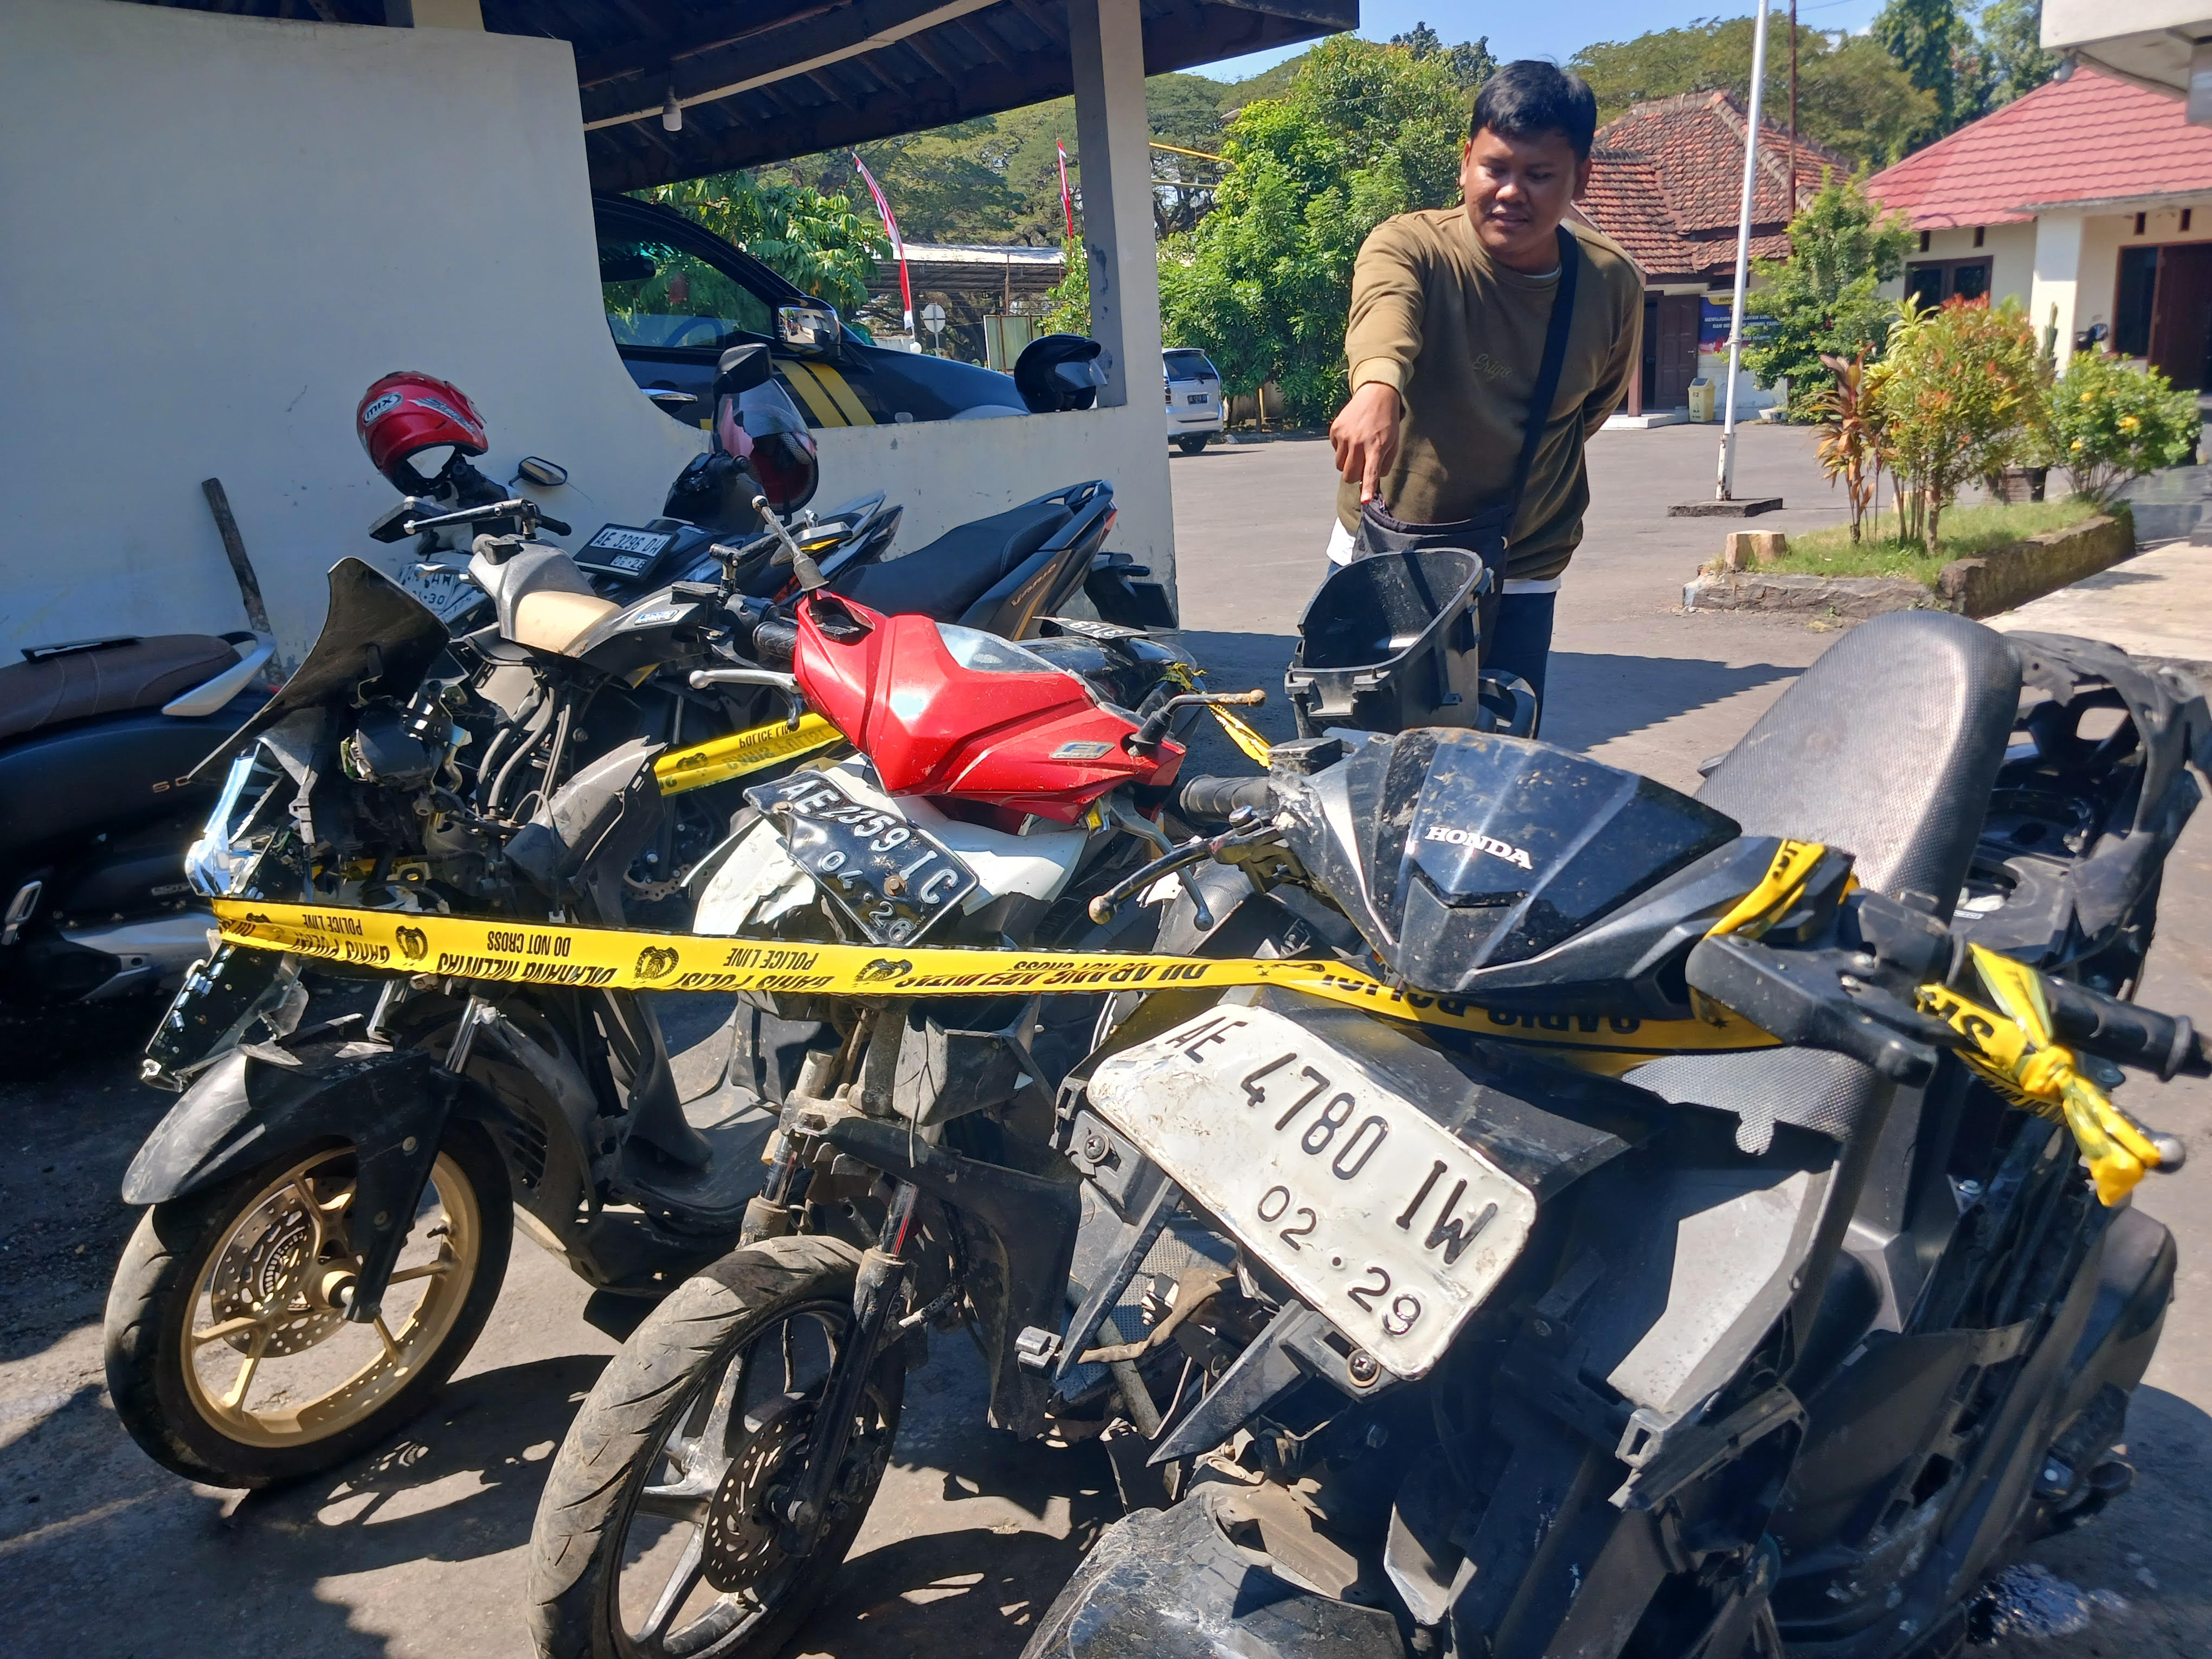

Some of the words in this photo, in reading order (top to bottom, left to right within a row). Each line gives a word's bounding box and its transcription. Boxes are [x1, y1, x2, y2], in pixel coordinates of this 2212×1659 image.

[594, 532, 617, 546] AE
[613, 534, 645, 550] 3296
[777, 779, 841, 814] AE
[819, 806, 910, 852] 2359
[900, 850, 959, 904] IC
[1425, 826, 1534, 870] HONDA
[302, 914, 324, 931] LINE
[326, 916, 363, 936] POLICE
[487, 931, 524, 953] CROSS
[526, 934, 551, 955] NOT
[554, 937, 571, 957] DO
[723, 948, 762, 967] LINE
[760, 950, 819, 970] POLICE
[1165, 1016, 1248, 1064] AE
[1240, 1052, 1389, 1181] 4780
[1396, 1159, 1498, 1265] IW
